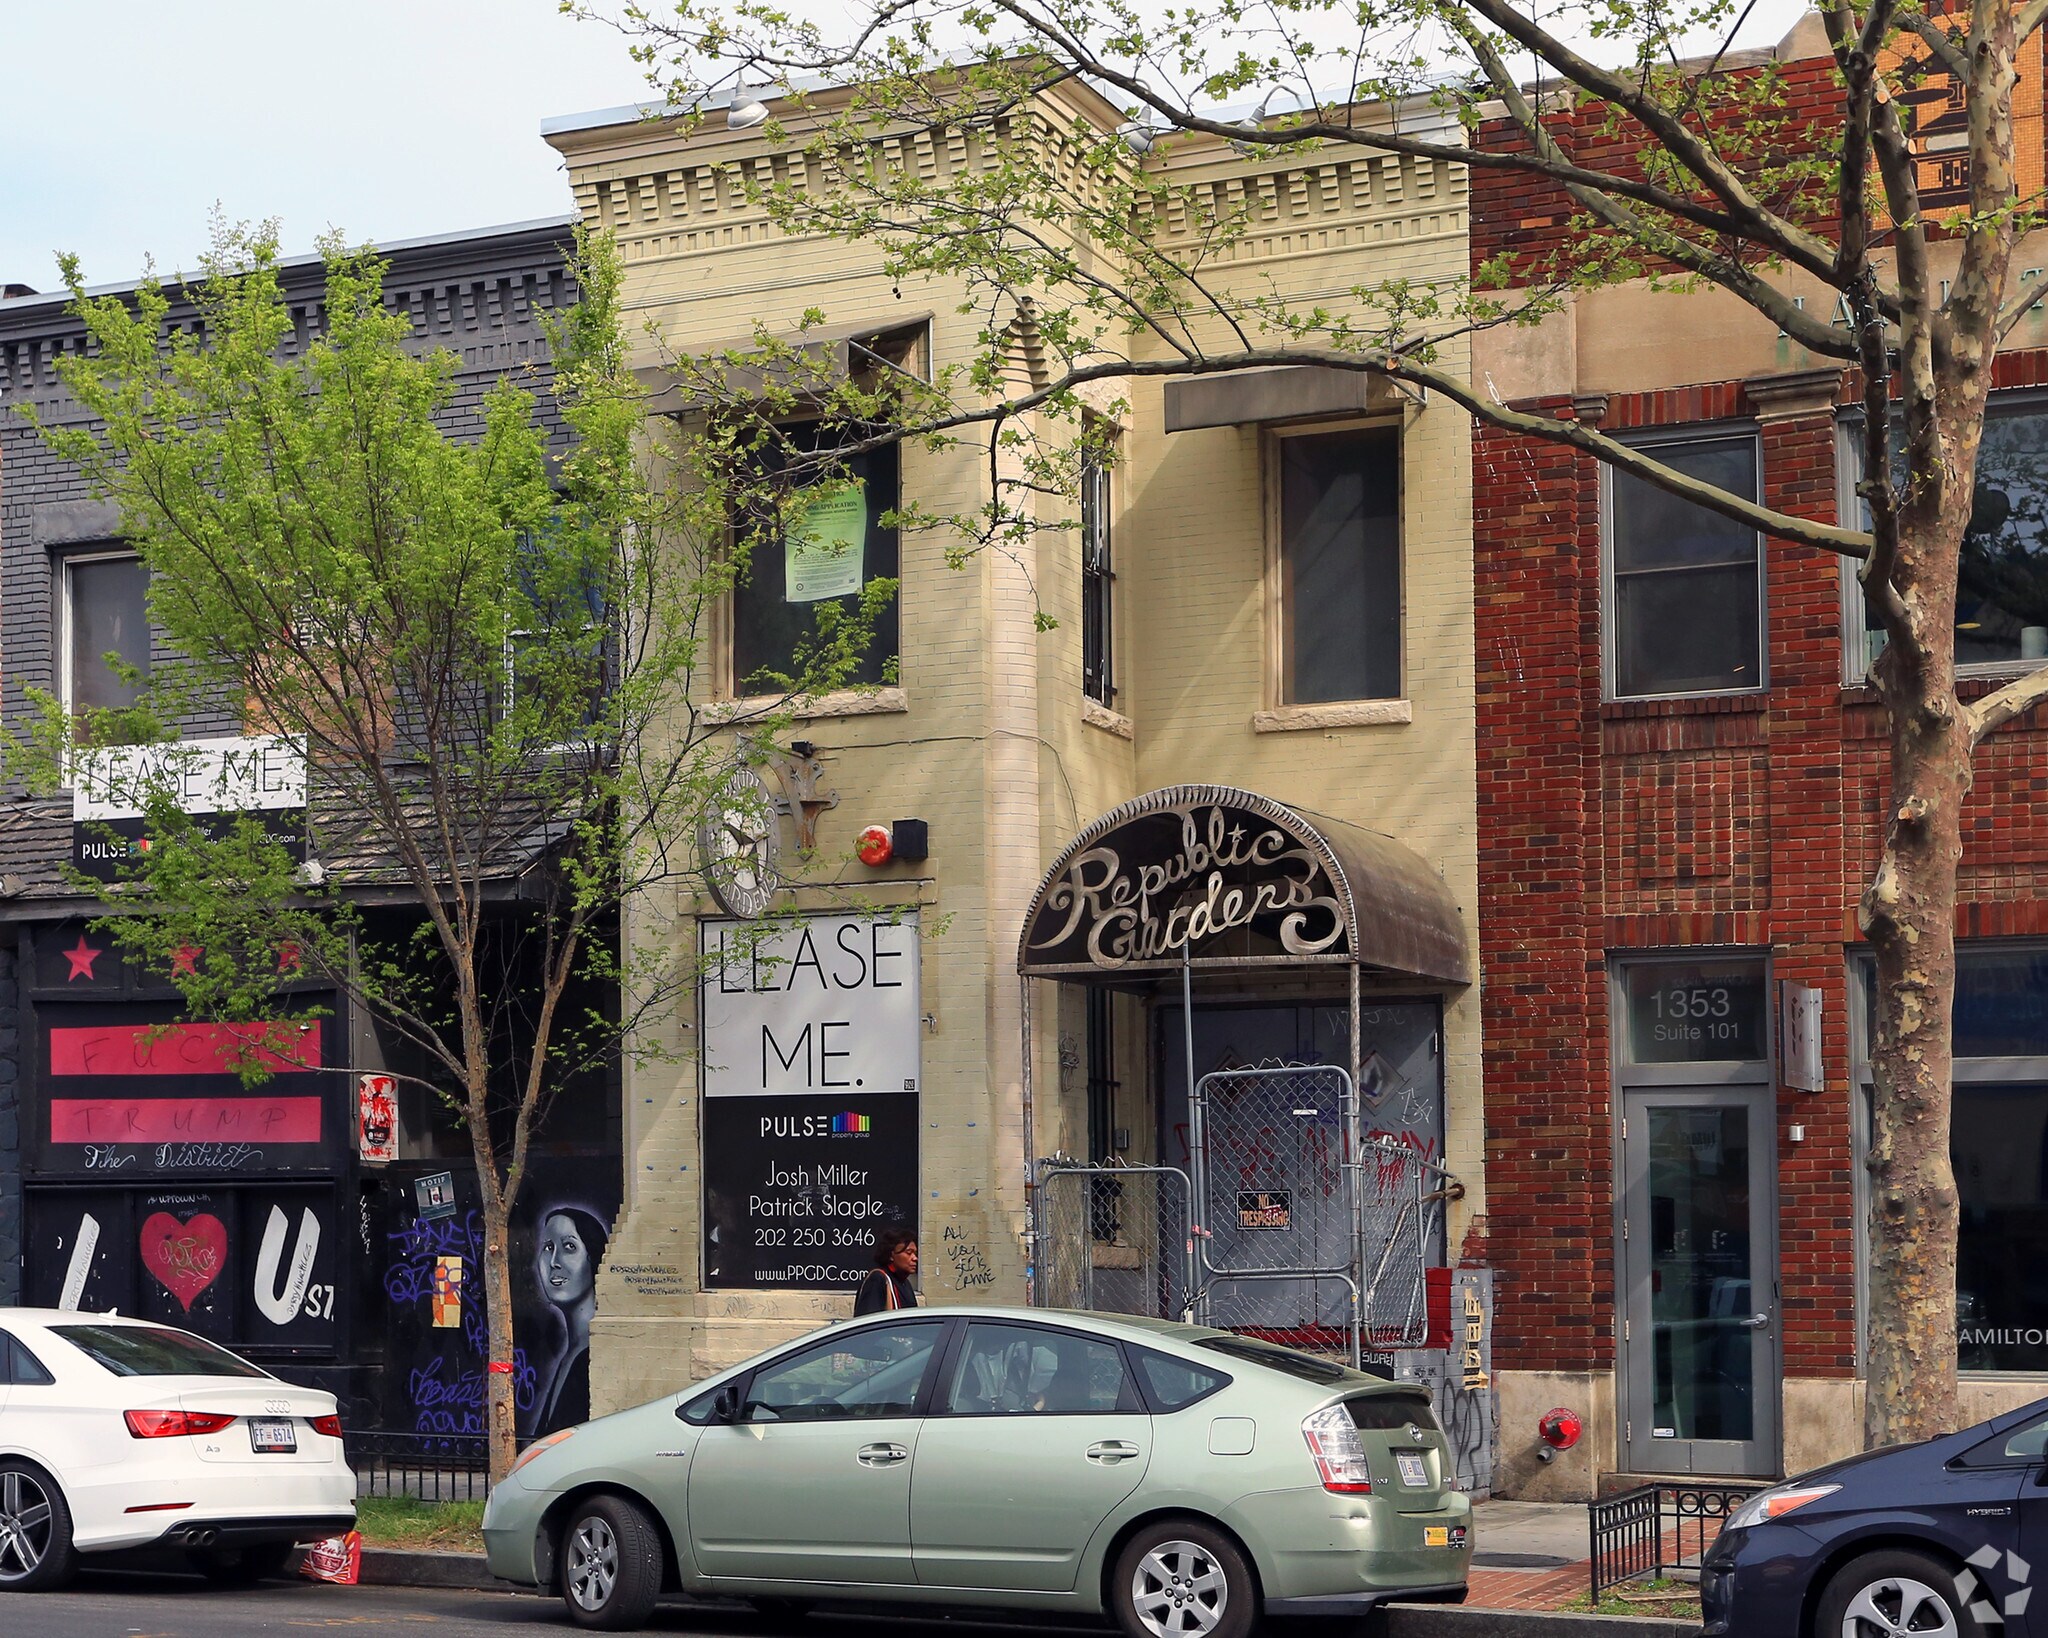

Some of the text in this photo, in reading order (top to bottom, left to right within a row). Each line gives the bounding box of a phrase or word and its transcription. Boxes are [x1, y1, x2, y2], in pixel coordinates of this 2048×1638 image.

[88, 752, 202, 804] LEASE
[82, 841, 127, 860] PULSE
[1027, 805, 1284, 948] Republic
[1087, 850, 1344, 968] Gardens
[720, 923, 902, 994] LEASE
[1650, 988, 1731, 1018] 1353
[1654, 1023, 1739, 1041] Suite 101
[762, 1021, 864, 1088] ME.
[73, 1107, 287, 1134] TRUMP
[760, 1116, 828, 1138] PULSE
[84, 1142, 263, 1168] The District
[765, 1161, 868, 1187] Josh Miller
[750, 1195, 814, 1217] Patrick
[821, 1195, 884, 1220] Slagle
[1258, 1193, 1270, 1209] NO
[754, 1228, 876, 1246] 202 250 3646
[254, 1204, 321, 1325] U
[754, 1265, 869, 1282] www.PPGDC.com
[1958, 1328, 2048, 1345] AMILTO
